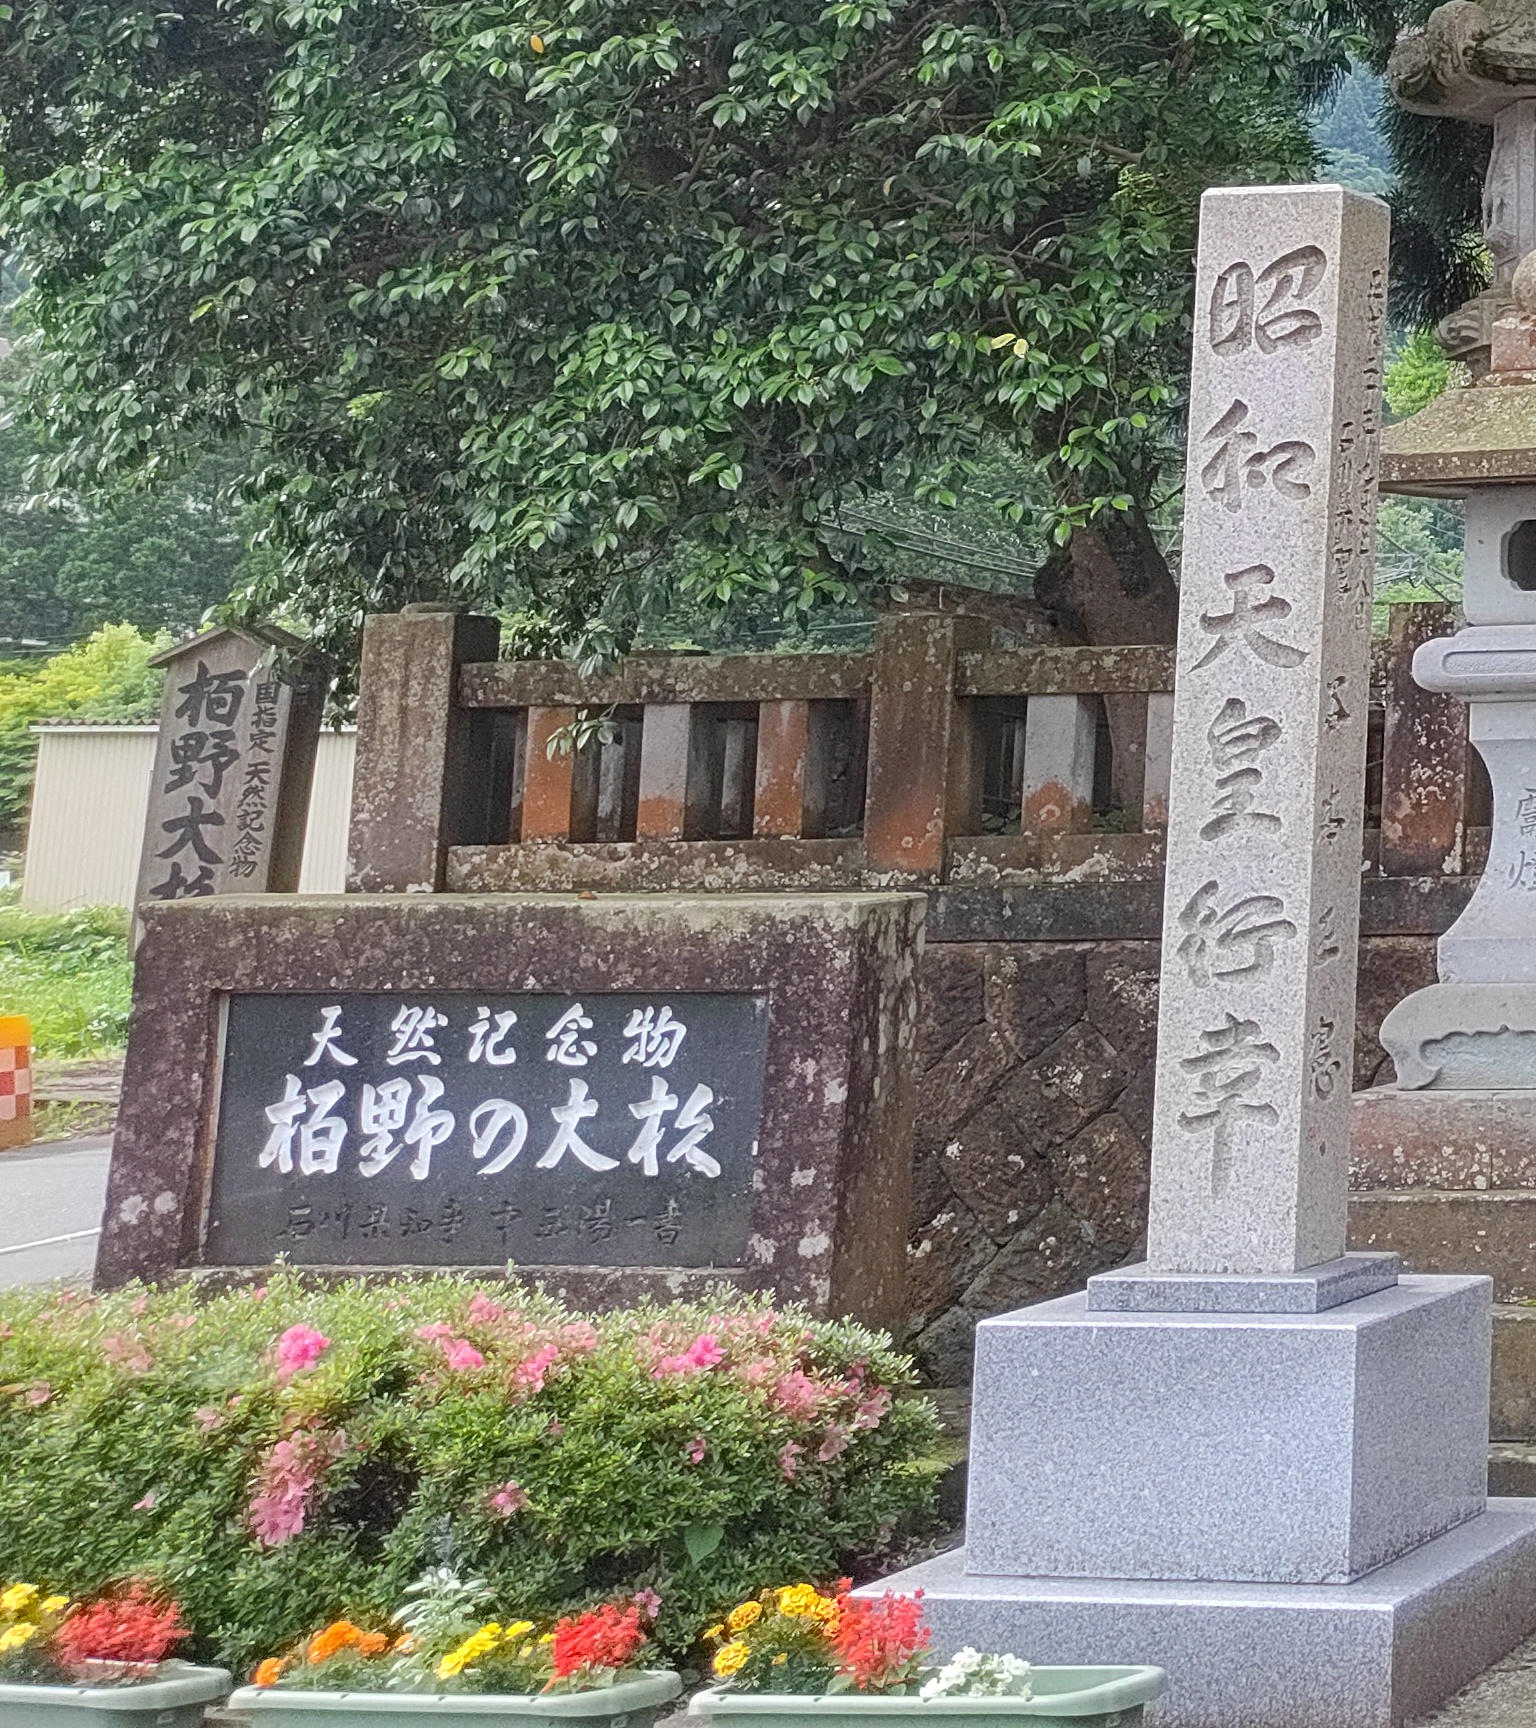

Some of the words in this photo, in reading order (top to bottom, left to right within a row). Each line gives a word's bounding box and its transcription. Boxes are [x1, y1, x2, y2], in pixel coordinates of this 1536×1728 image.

[1178, 242, 1328, 1197] 昭和天皇行幸
[304, 1002, 689, 1067] 天然記念物
[258, 1072, 723, 1180] 栢野の大杉
